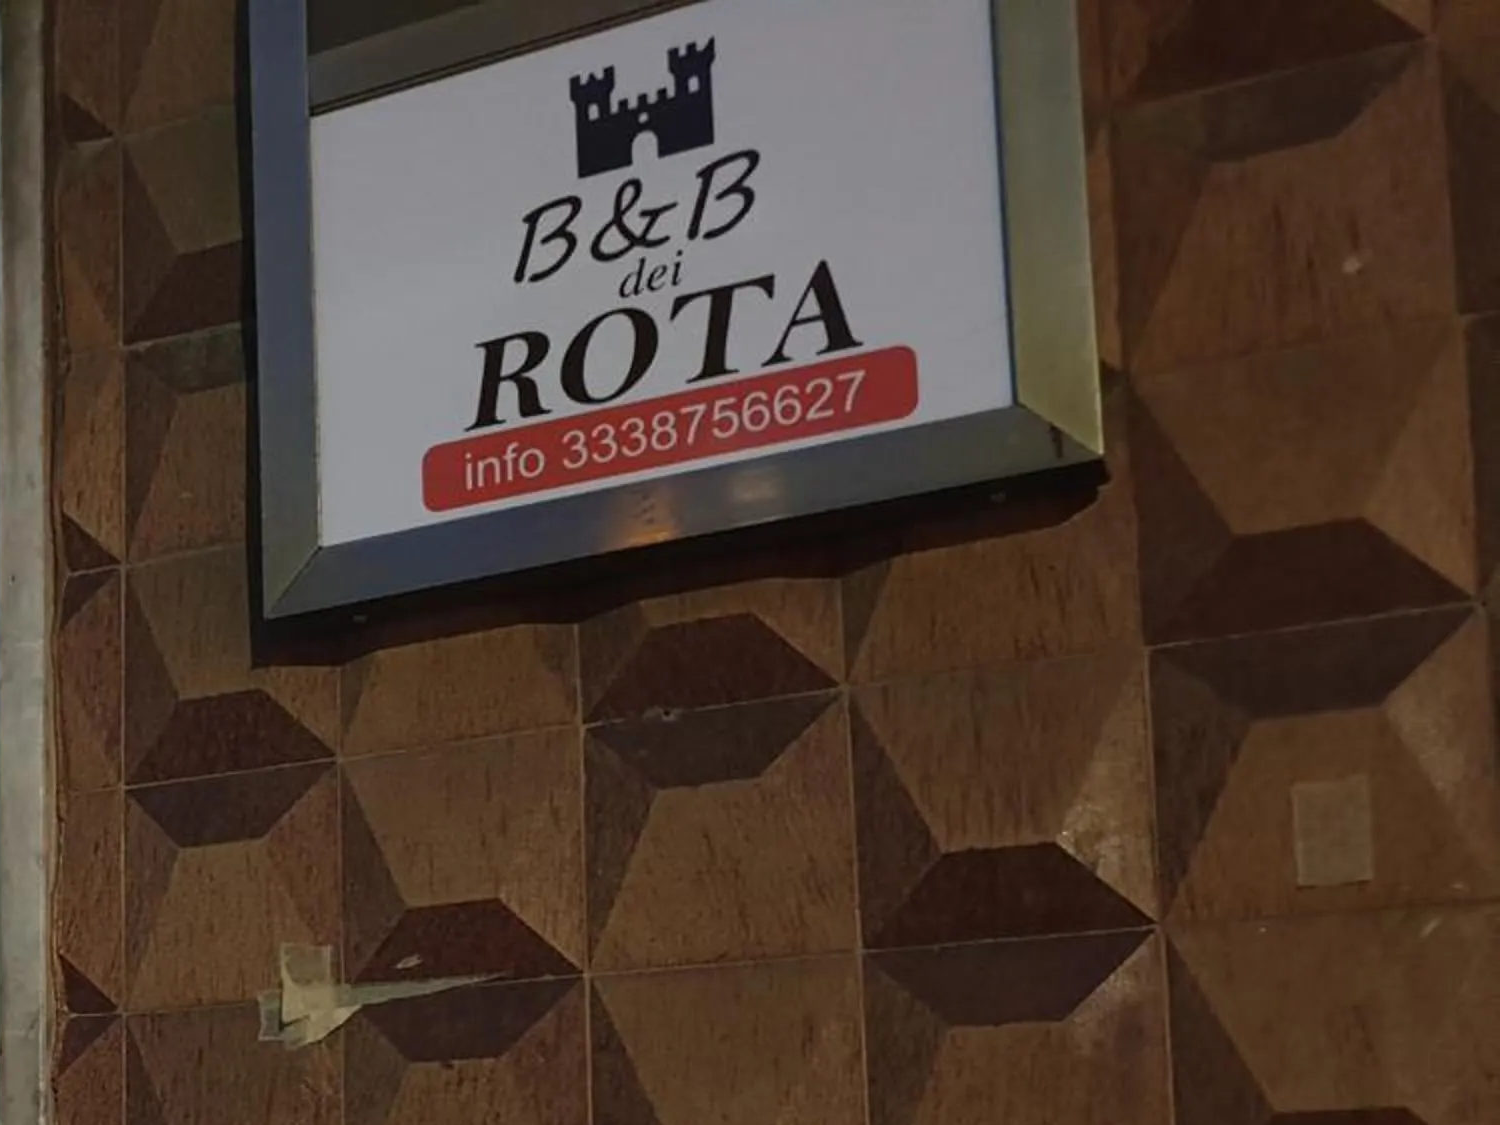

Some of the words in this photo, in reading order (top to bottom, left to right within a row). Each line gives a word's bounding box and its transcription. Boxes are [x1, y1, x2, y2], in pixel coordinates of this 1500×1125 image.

[512, 148, 762, 284] B&B
[618, 250, 684, 299] dei
[463, 259, 865, 433] ROTA
[464, 442, 546, 491] info
[561, 370, 866, 470] 3338756627
